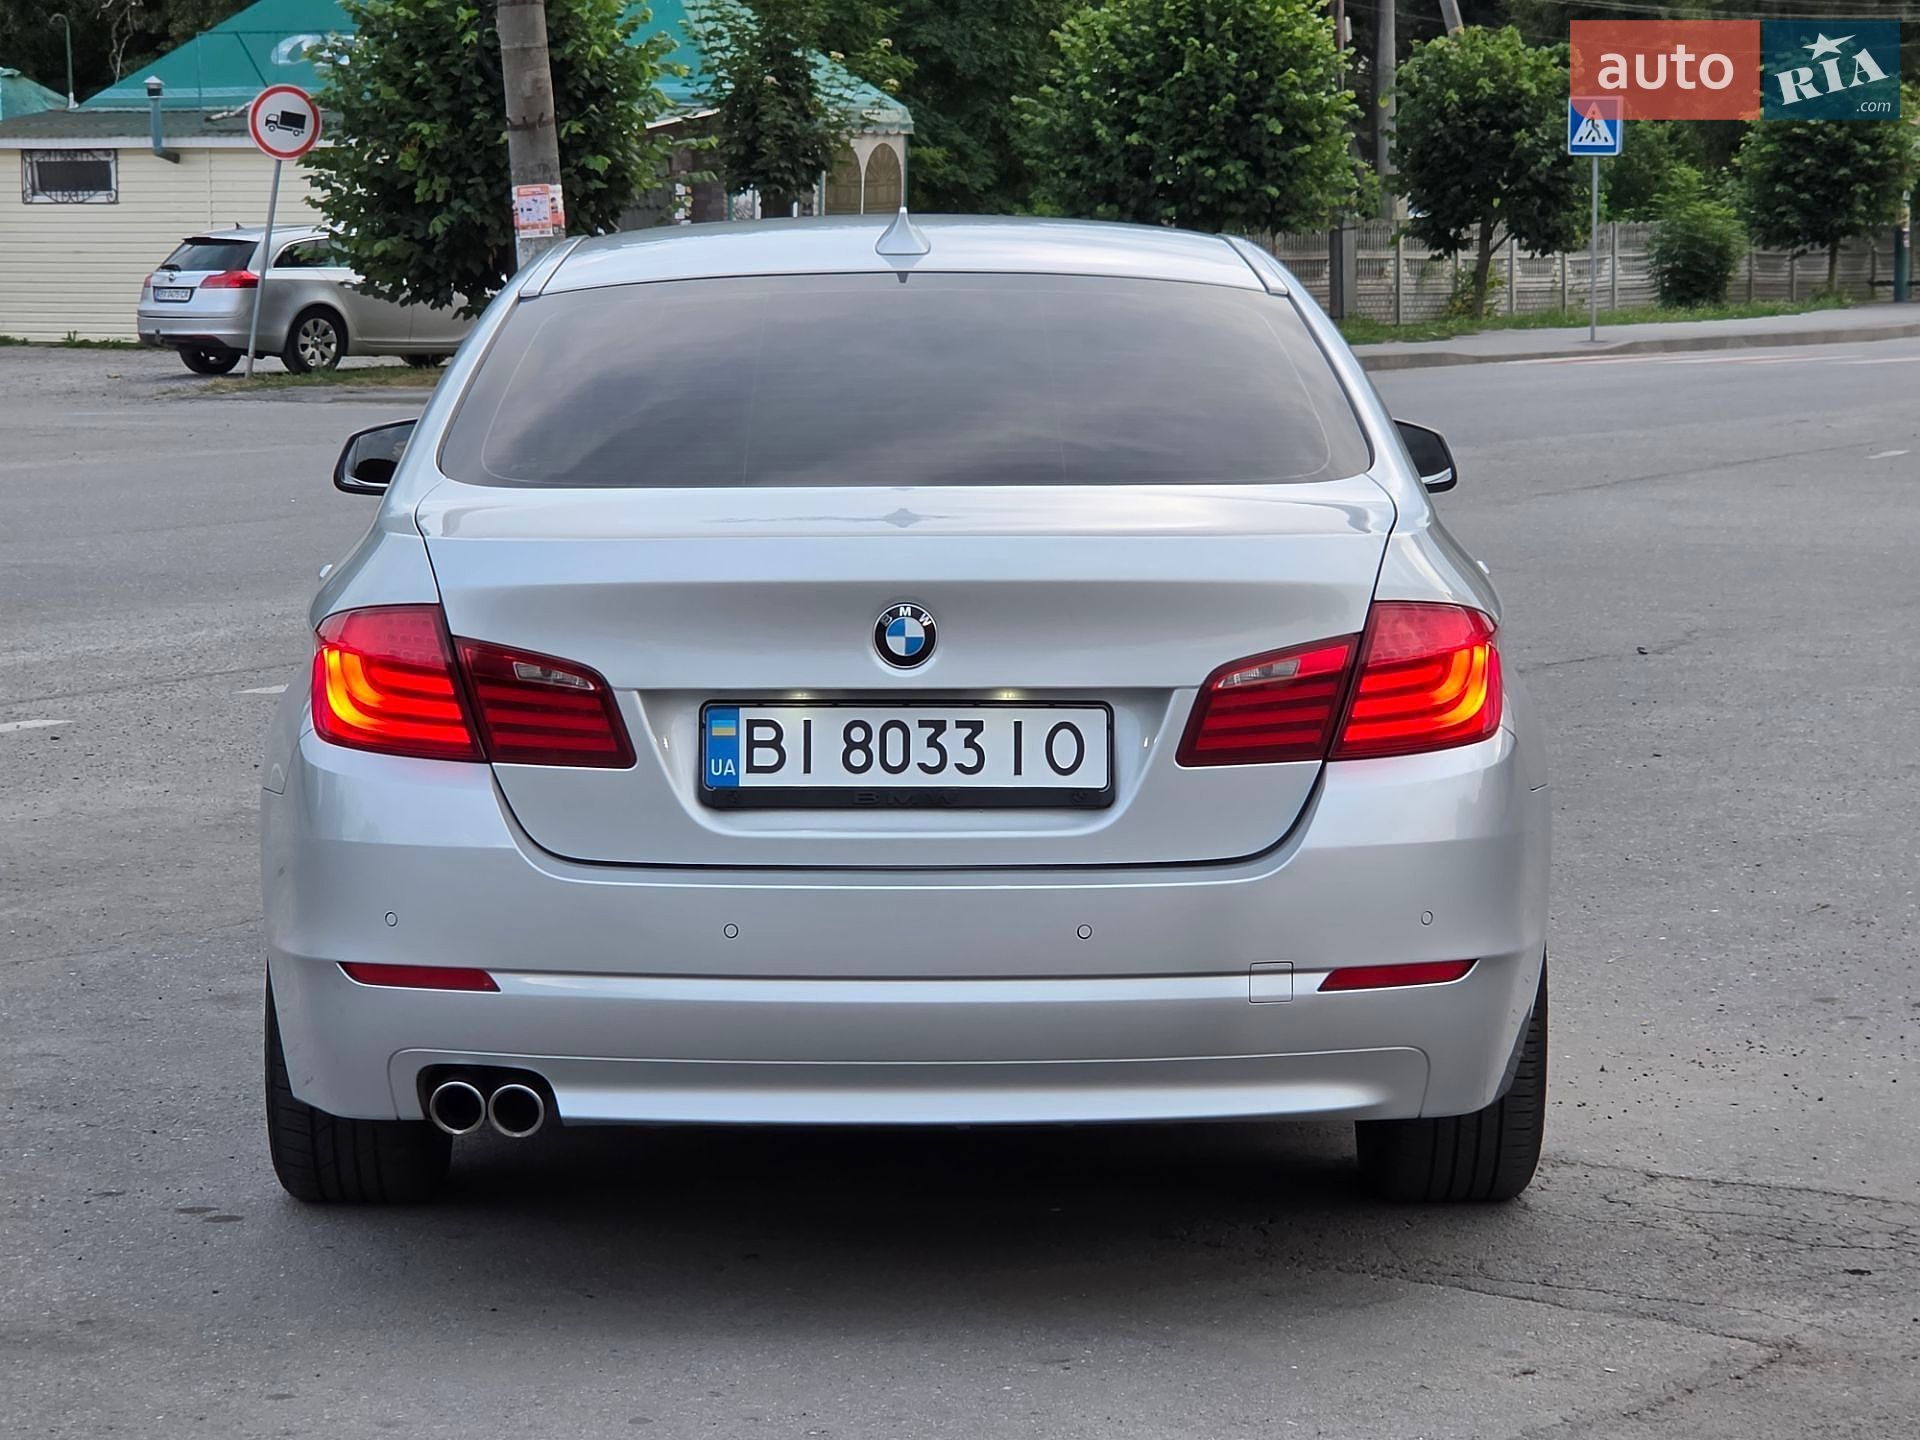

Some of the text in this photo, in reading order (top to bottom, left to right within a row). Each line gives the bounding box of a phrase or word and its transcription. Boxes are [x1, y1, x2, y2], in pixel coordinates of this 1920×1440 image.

[880, 606, 933, 627] BMW
[745, 718, 1085, 777] BI 8033 IO
[711, 759, 736, 776] UA
